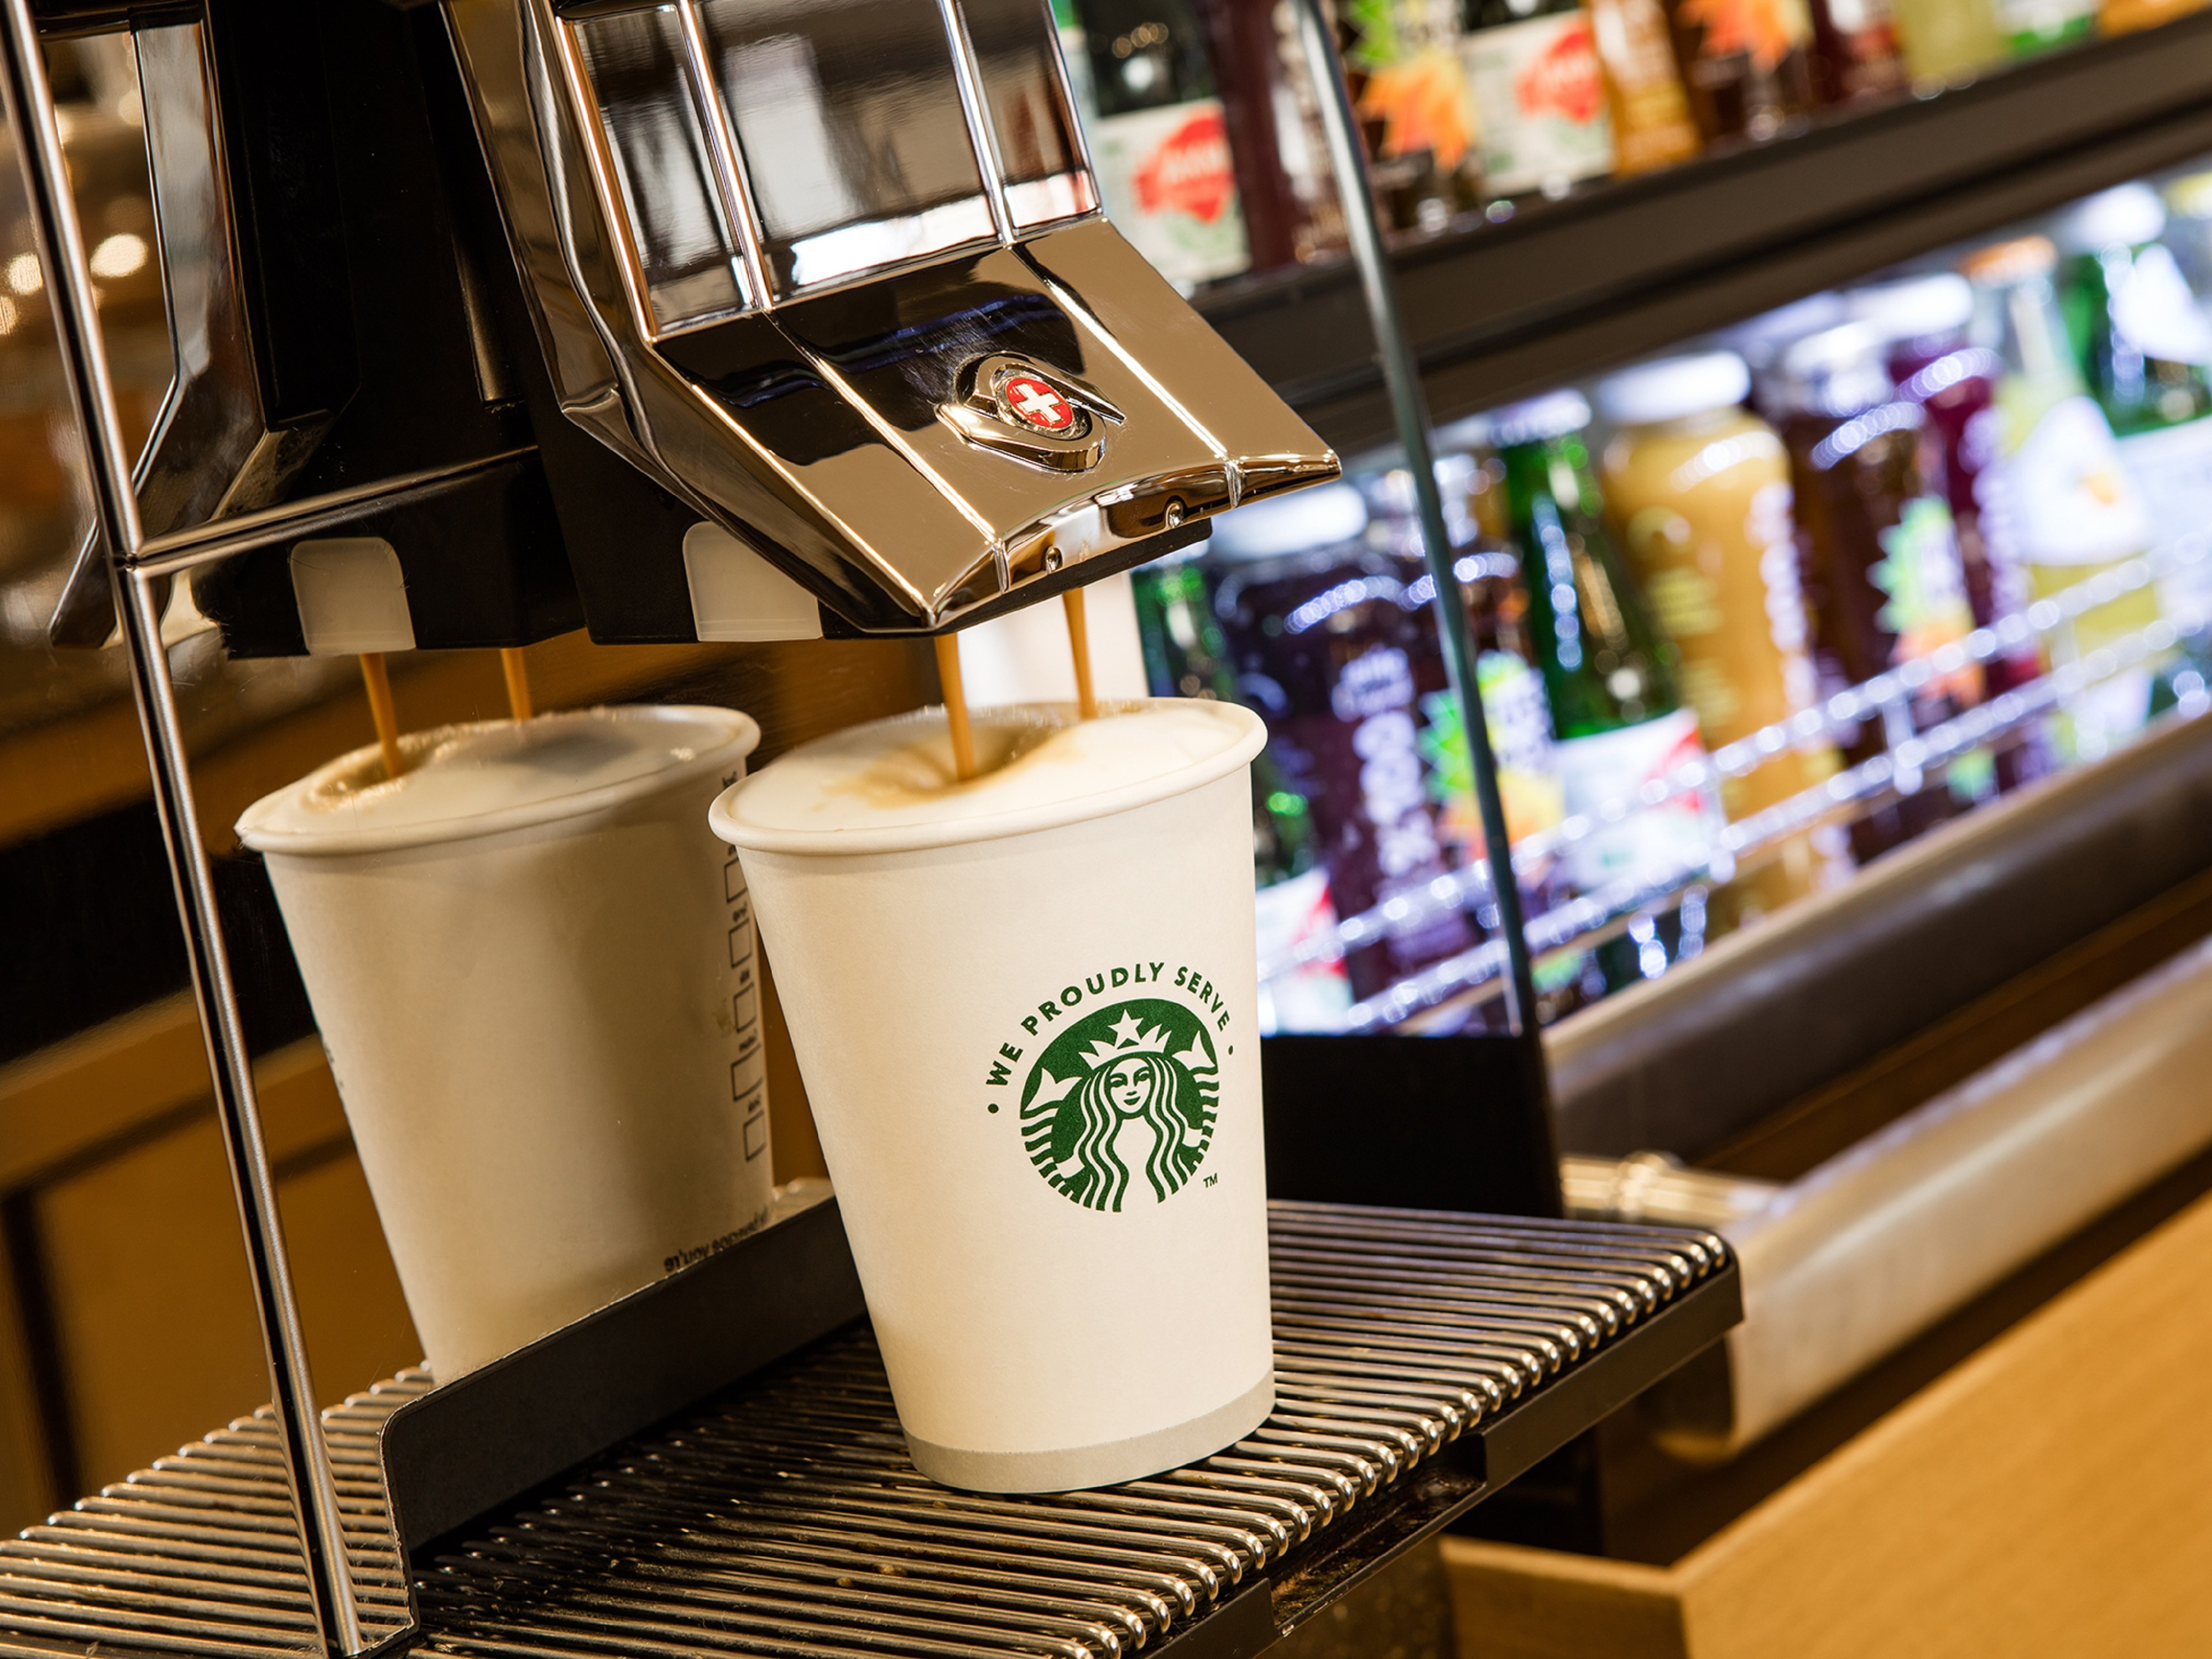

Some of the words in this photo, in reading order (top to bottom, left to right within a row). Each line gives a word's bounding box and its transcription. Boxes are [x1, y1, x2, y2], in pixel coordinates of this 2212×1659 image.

[985, 1042, 1024, 1086] WE
[1020, 962, 1165, 1036] PROUDLY
[1173, 966, 1230, 1032] SERVE
[1203, 1172, 1218, 1188] TM
